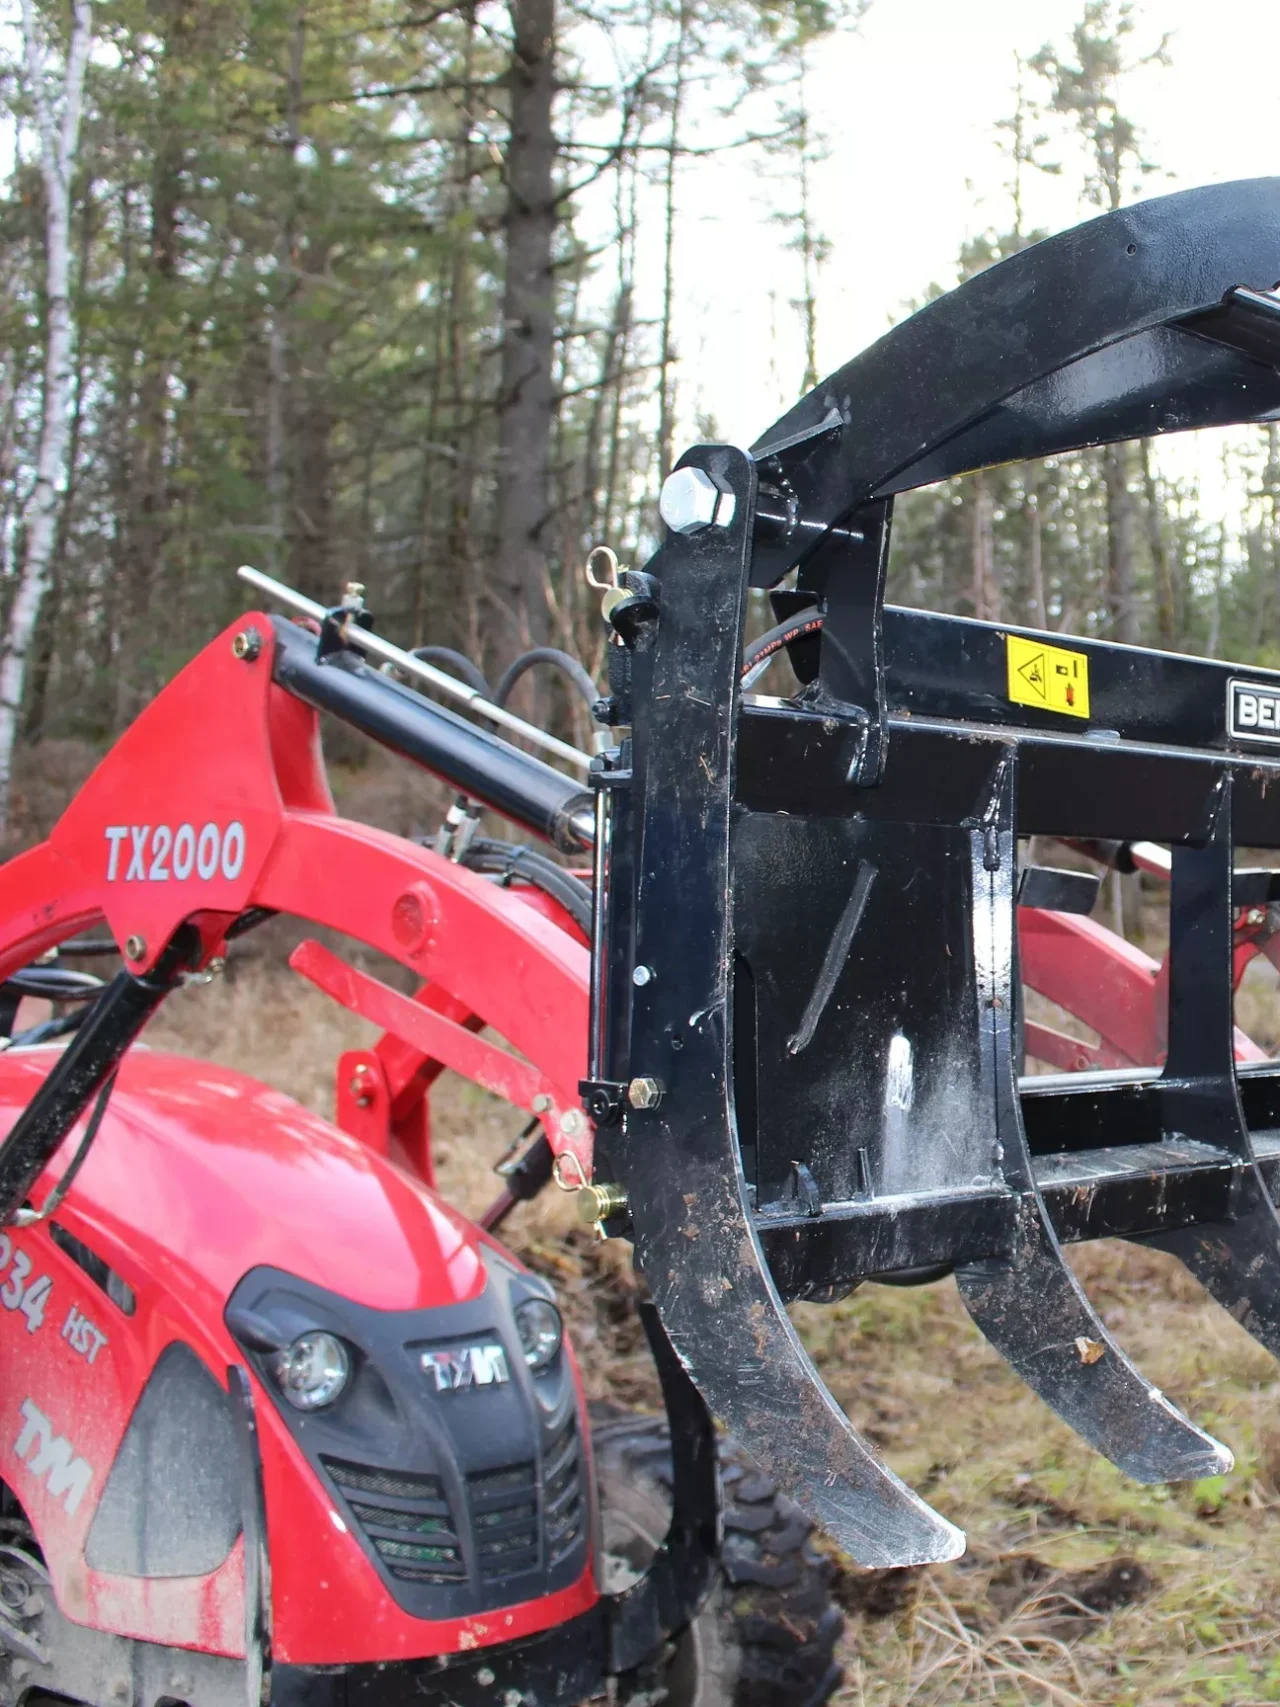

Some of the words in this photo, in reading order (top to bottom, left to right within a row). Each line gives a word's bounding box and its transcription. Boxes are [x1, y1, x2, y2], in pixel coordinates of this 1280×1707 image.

[784, 628, 799, 641] WP
[104, 820, 246, 881] TX2000
[61, 1306, 109, 1365] HST
[421, 1345, 510, 1392] TYM
[13, 1396, 94, 1517] TYM
